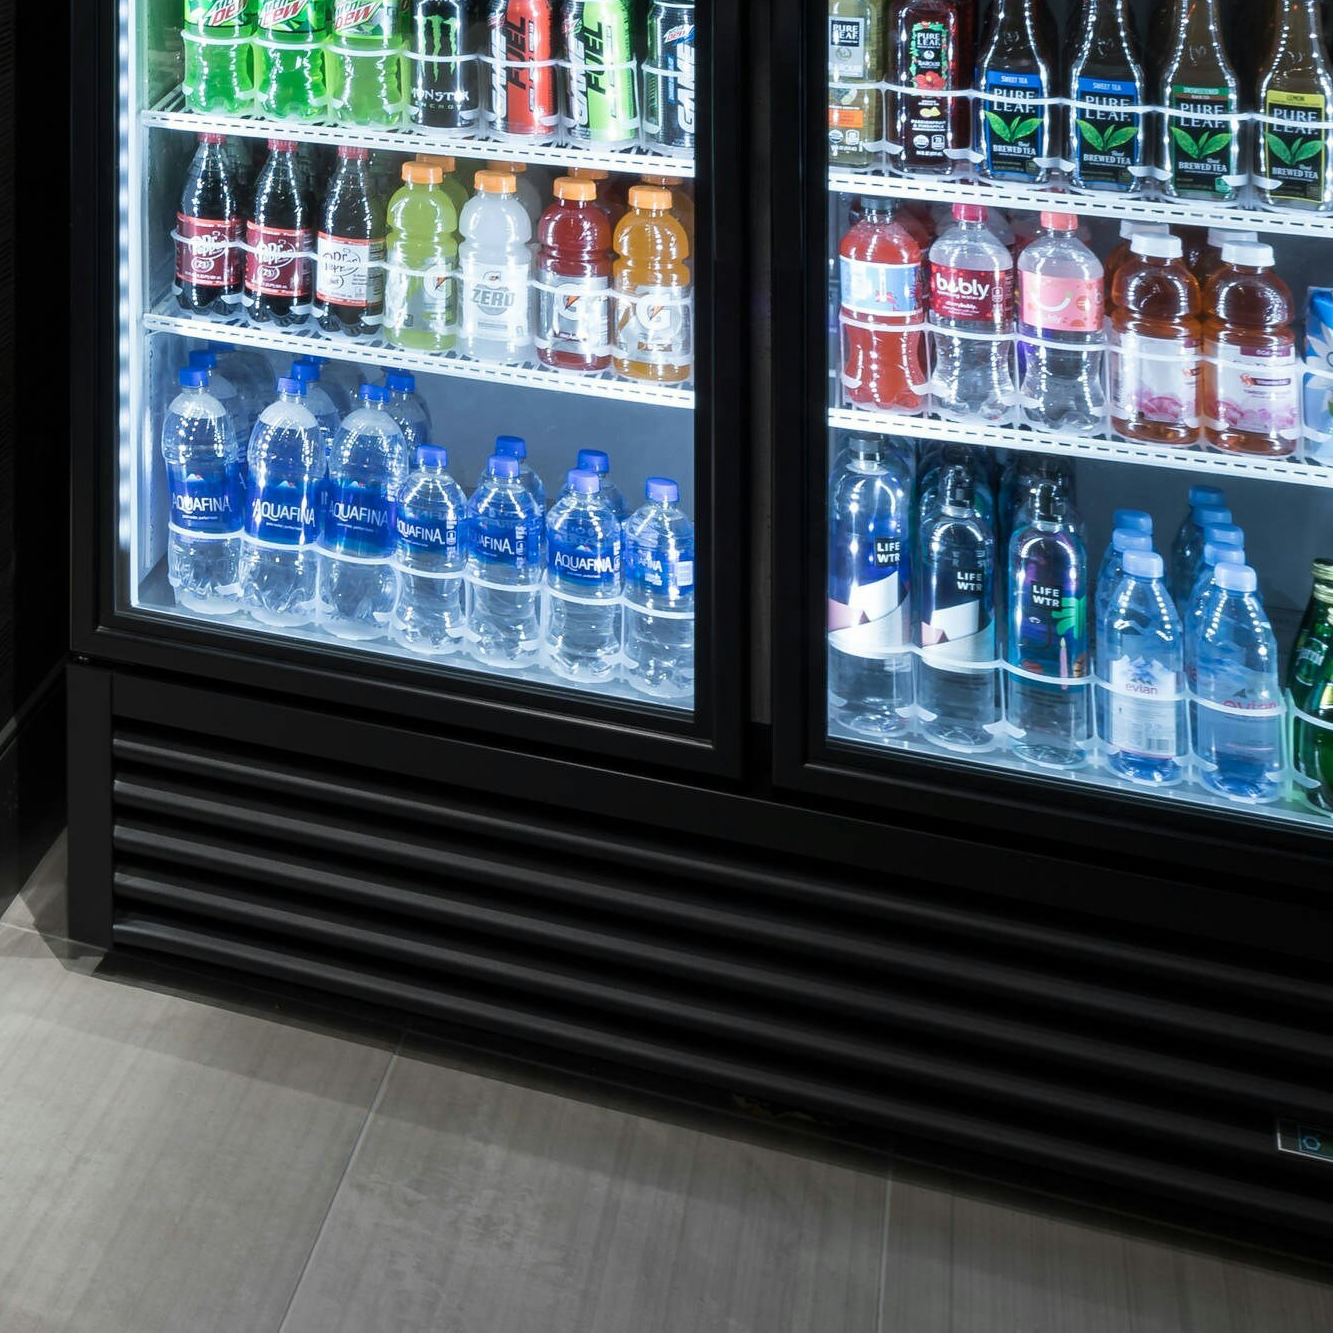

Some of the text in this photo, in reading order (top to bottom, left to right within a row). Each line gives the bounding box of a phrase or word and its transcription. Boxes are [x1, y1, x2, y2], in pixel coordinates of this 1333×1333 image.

[833, 24, 859, 33] PURE
[917, 33, 940, 41] PURE
[917, 40, 941, 48] LEAF
[994, 102, 1036, 114] LEAF
[1180, 102, 1224, 115] PURE
[1273, 107, 1318, 121] PURE
[992, 145, 1037, 156] BREWED TEA
[1083, 153, 1132, 165] BREWED TEA
[1178, 161, 1228, 172] BREWED TEA
[1271, 167, 1319, 180] BREWED TEA
[471, 288, 515, 308] ZERO
[172, 495, 232, 514] AQUAFINA
[252, 498, 316, 528] AQUAFINA
[331, 502, 389, 525] AQUAFINA
[396, 517, 445, 545] AQUAFINA
[876, 542, 901, 553] LIFE
[554, 550, 615, 574] AQUAFINA
[876, 553, 901, 564] WTR
[956, 571, 983, 582] LIFE
[956, 581, 983, 592] WTR
[1032, 584, 1060, 597] LIFE
[1032, 594, 1061, 608] WTR
[1124, 680, 1159, 696] evian
